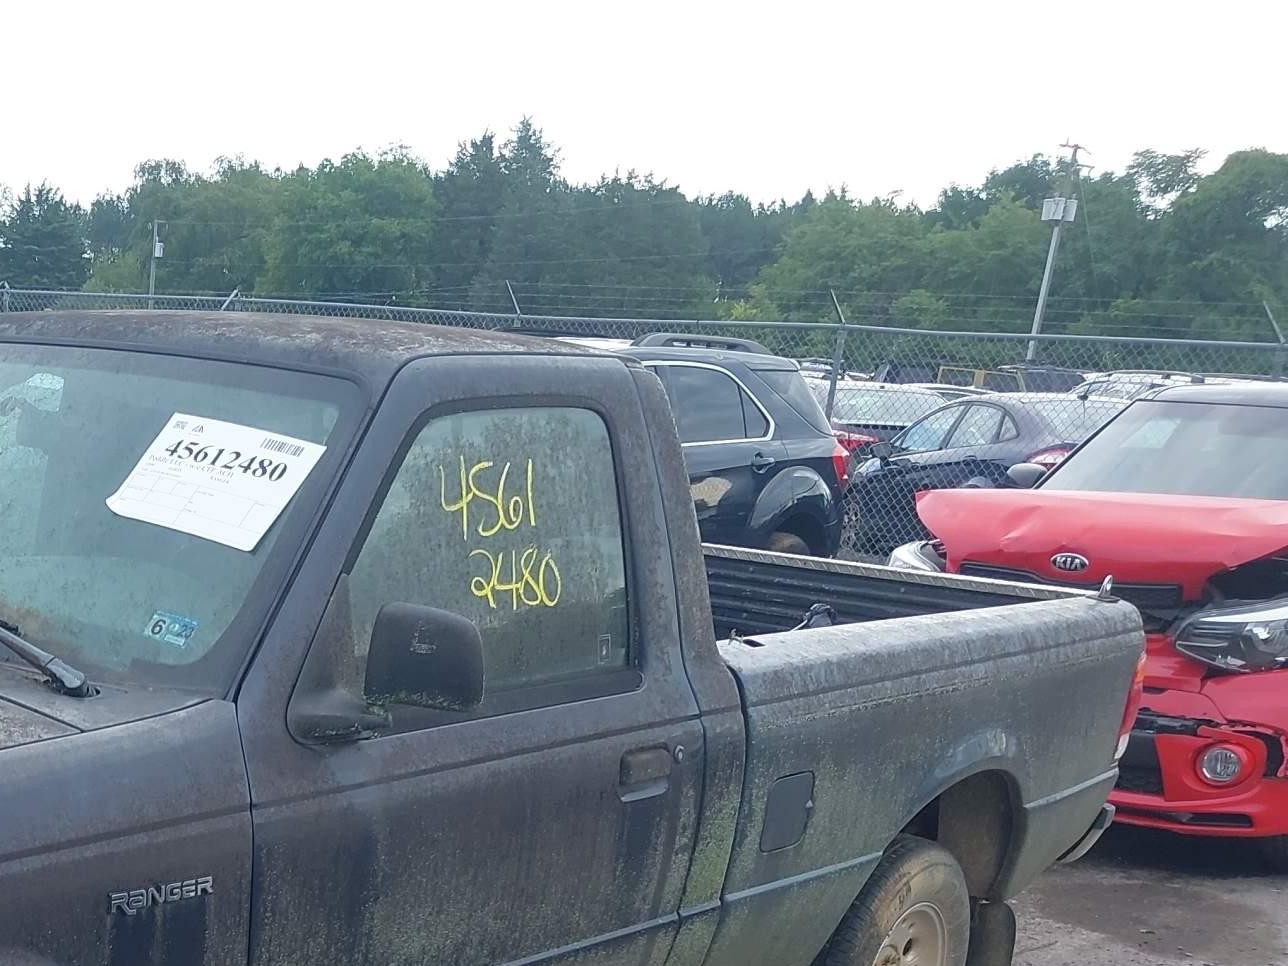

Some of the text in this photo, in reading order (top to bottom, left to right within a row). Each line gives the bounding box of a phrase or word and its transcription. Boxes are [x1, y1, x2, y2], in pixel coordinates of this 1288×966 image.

[165, 439, 289, 483] 45612480
[439, 455, 537, 541] 4561
[468, 543, 562, 611] 2480
[1055, 556, 1082, 570] KIA
[150, 619, 167, 636] 6
[111, 876, 215, 916] RANGER
